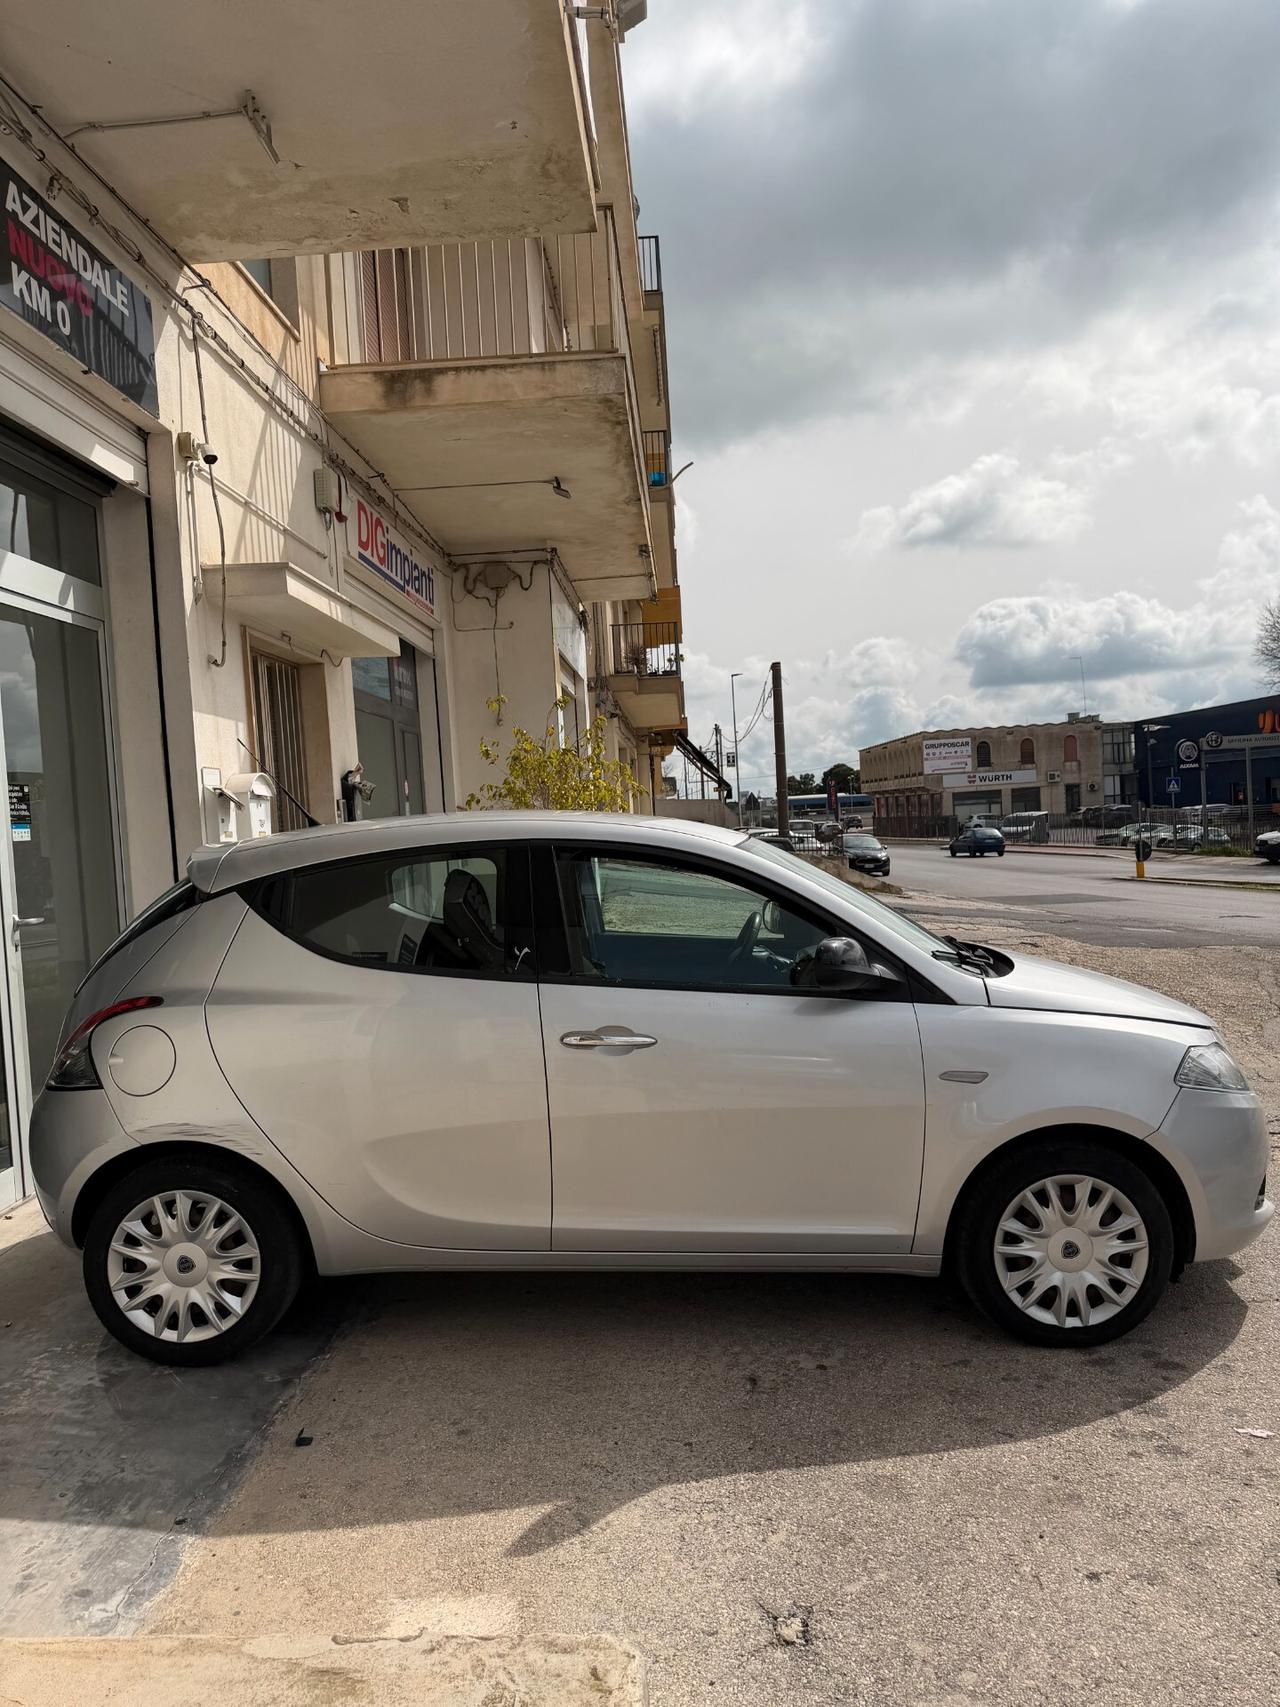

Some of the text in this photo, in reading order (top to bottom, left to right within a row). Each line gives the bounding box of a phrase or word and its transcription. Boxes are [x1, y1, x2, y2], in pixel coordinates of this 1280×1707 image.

[5, 180, 129, 317] AZIENDALE
[7, 218, 93, 317] NUOVO
[11, 261, 71, 336] KM 0
[924, 741, 970, 750] GRUPPOSCAR
